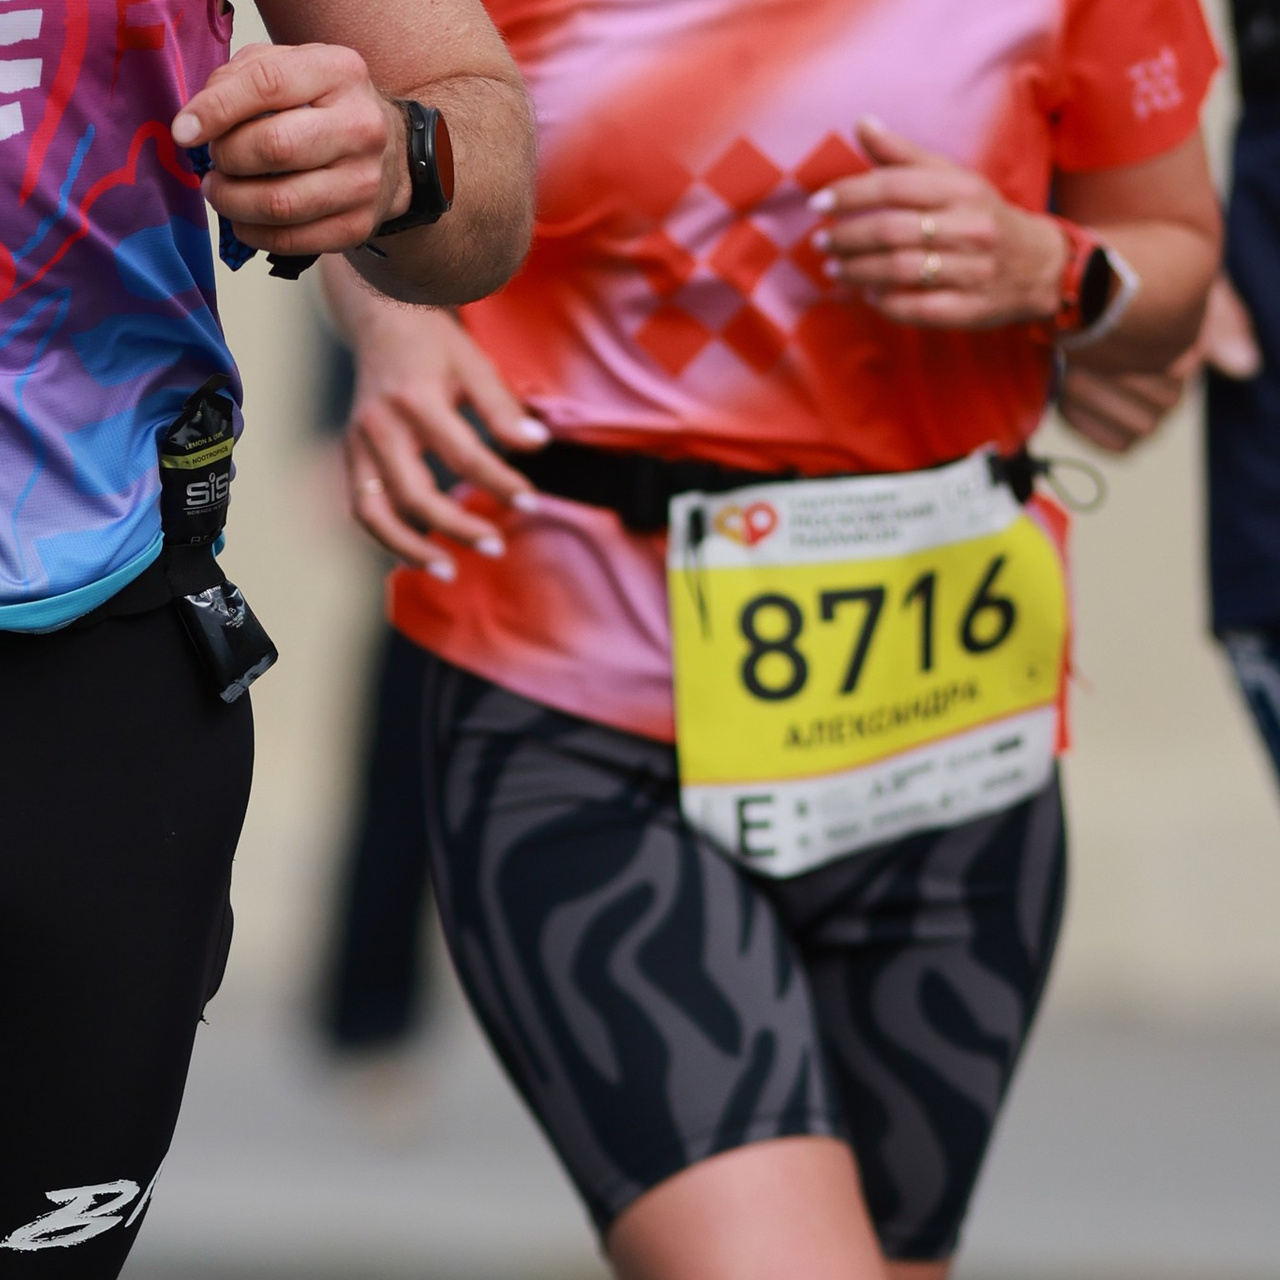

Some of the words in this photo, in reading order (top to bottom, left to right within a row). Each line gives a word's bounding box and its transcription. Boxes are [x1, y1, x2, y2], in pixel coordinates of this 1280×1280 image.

[185, 438, 207, 450] LEMON
[192, 445, 228, 464] NOOTROPICS
[738, 552, 1017, 702] 8716
[737, 795, 777, 856] E
